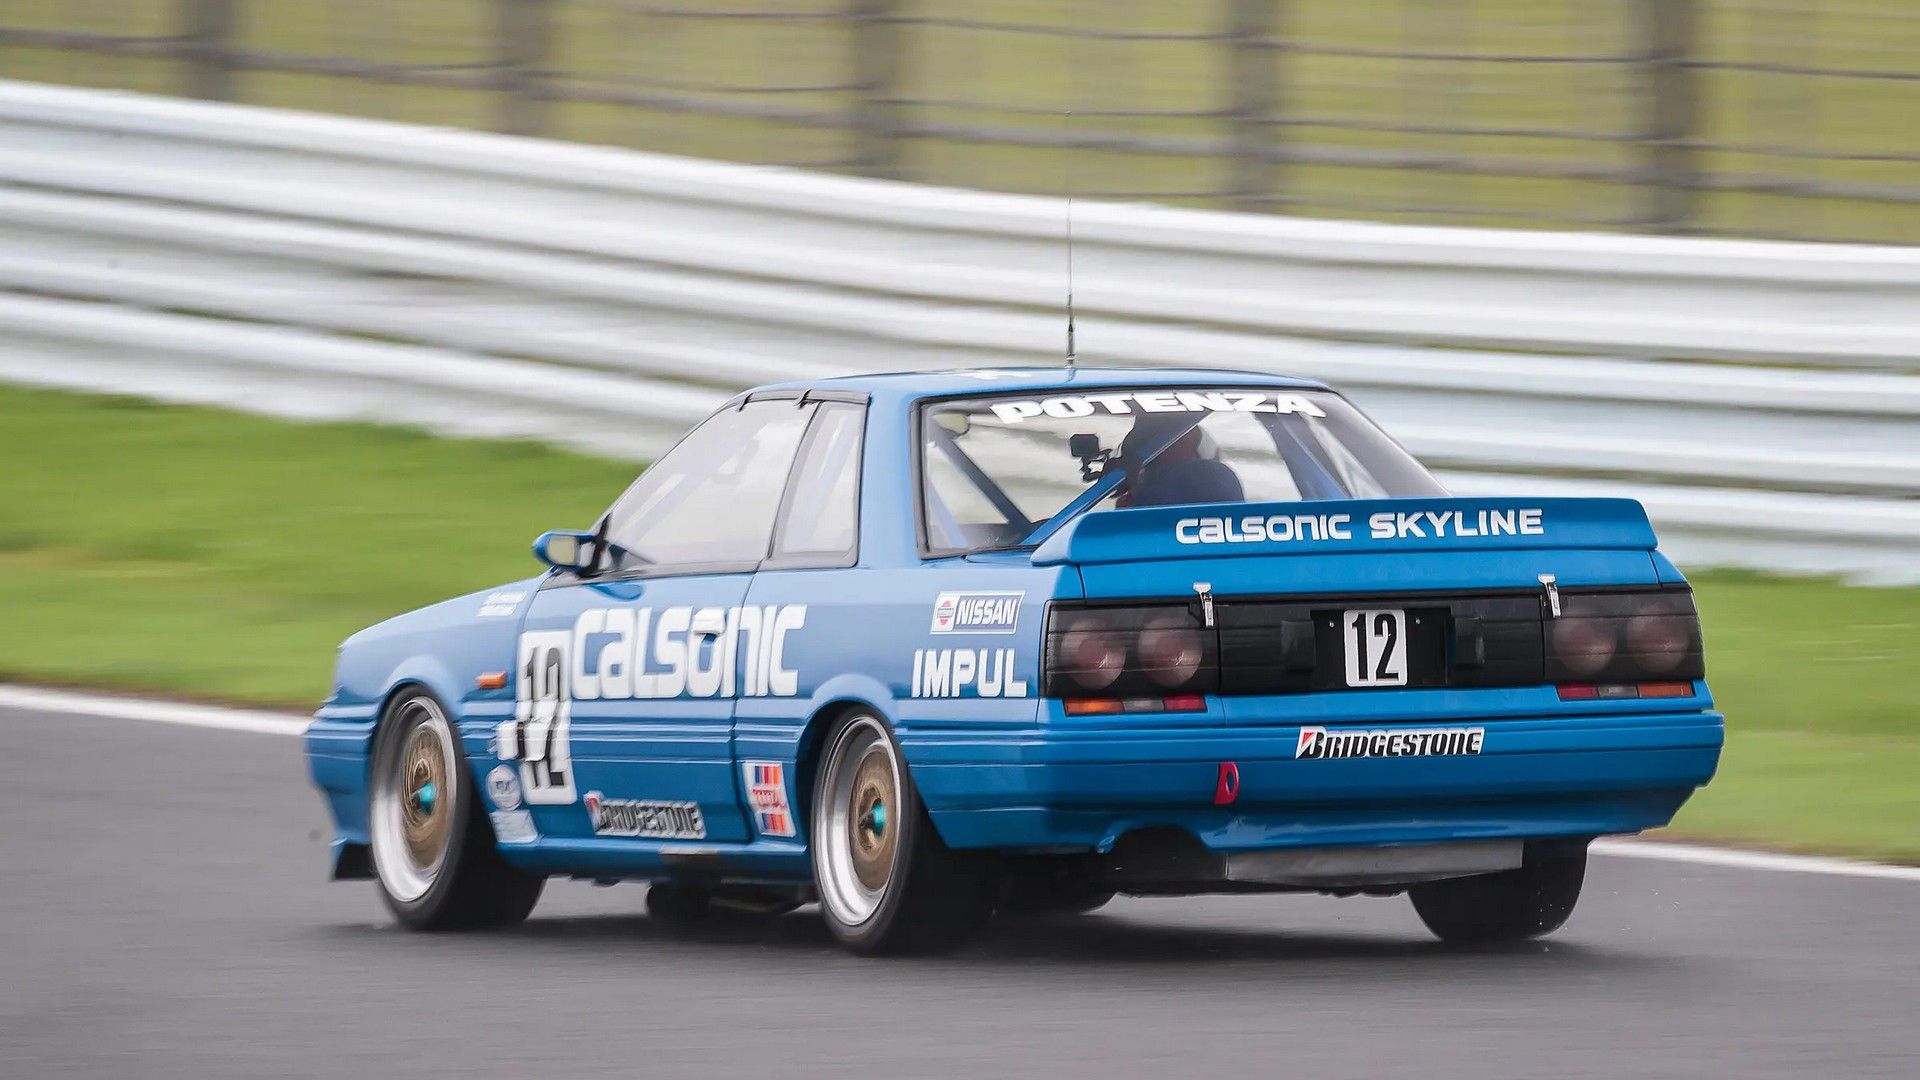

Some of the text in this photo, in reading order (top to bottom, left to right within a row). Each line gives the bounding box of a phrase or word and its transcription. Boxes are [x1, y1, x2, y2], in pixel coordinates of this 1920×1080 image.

[990, 392, 1326, 424] POTENZA
[1368, 508, 1545, 539] SKYLINE
[955, 599, 1017, 625] NISSAN
[1351, 613, 1399, 682] 12
[911, 648, 1027, 698] IMPUL
[519, 647, 566, 788] 12
[1297, 730, 1483, 759] BRIDGESTONE
